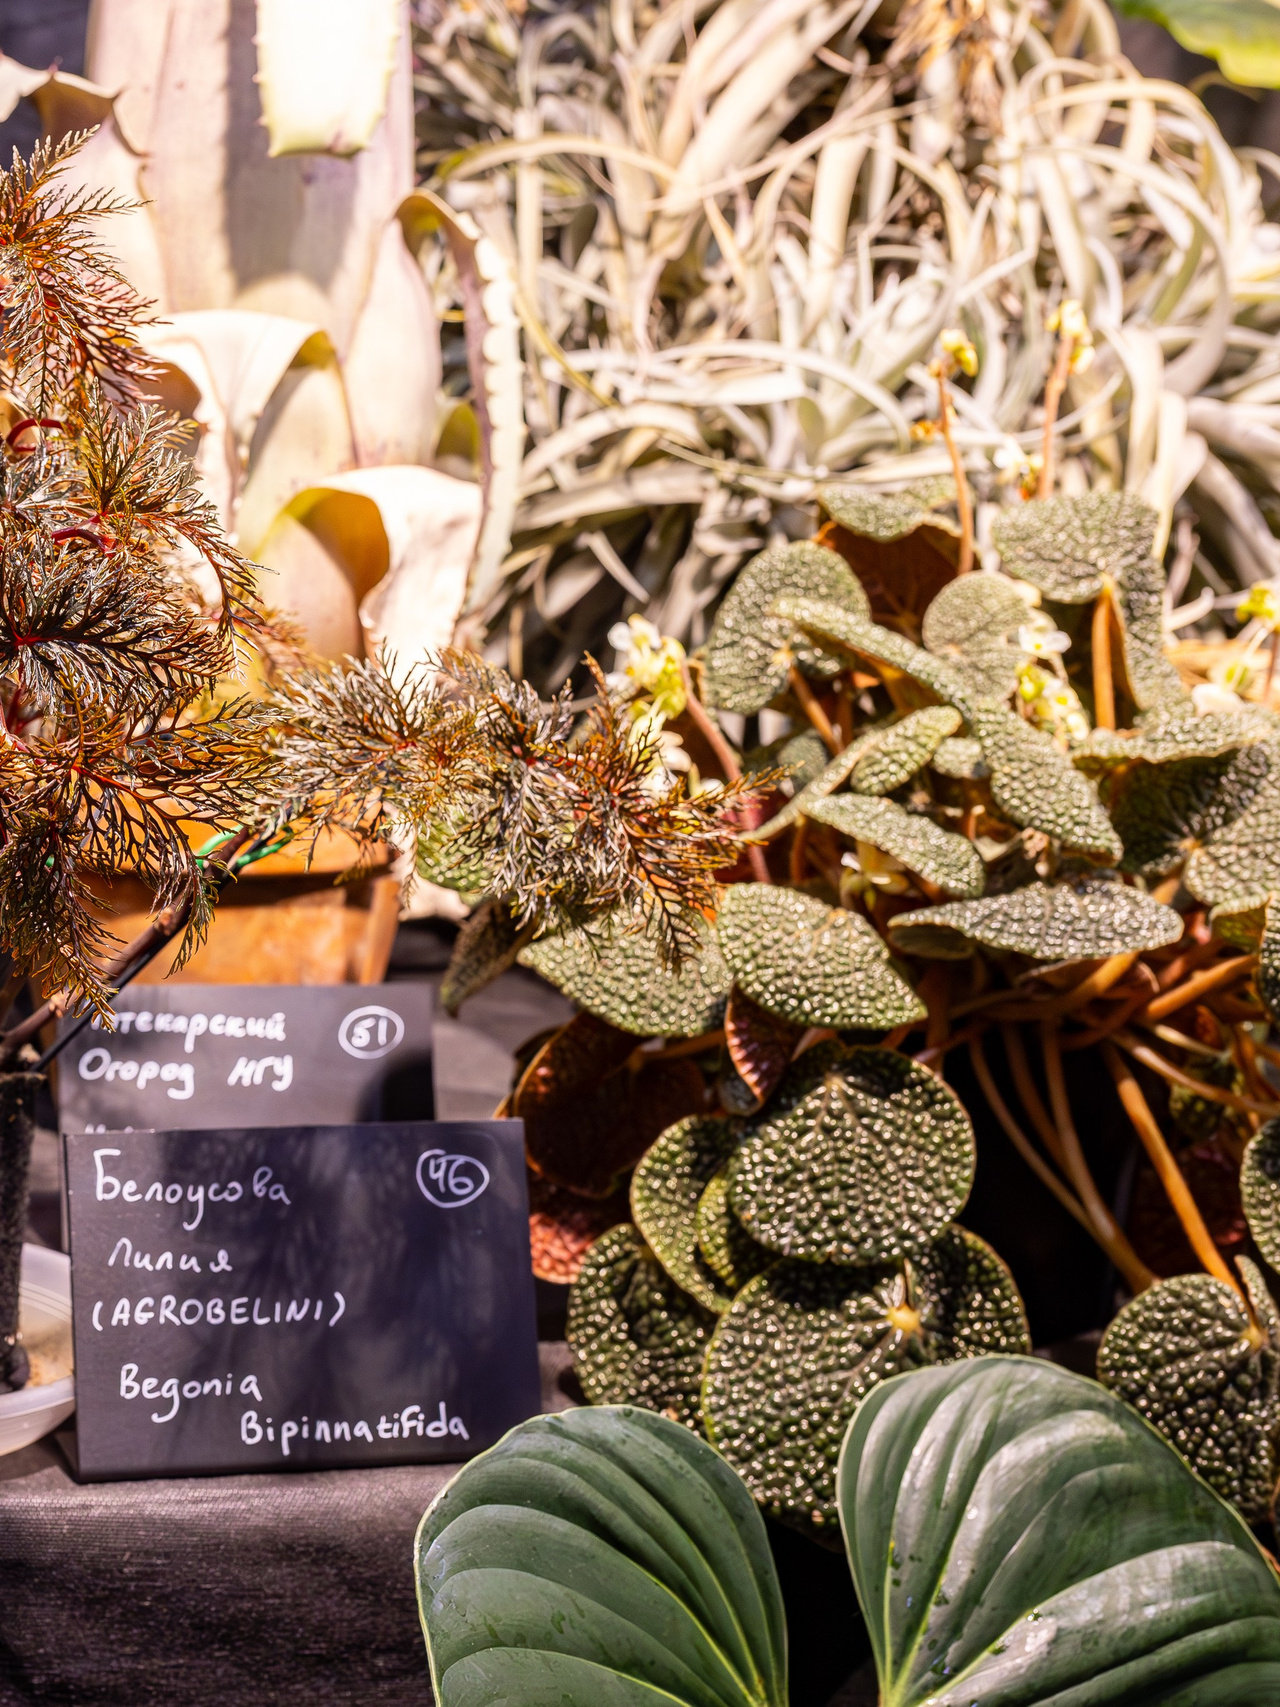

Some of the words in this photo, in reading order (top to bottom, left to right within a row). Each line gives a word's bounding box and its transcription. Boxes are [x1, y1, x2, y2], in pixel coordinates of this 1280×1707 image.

[78, 1047, 195, 1100] Огород
[227, 1054, 293, 1092] МГУ
[93, 1148, 292, 1231] Белоусова
[107, 1236, 232, 1273] Лилия
[91, 1291, 346, 1332] (AGROBELINI)
[119, 1362, 263, 1424] Begonia
